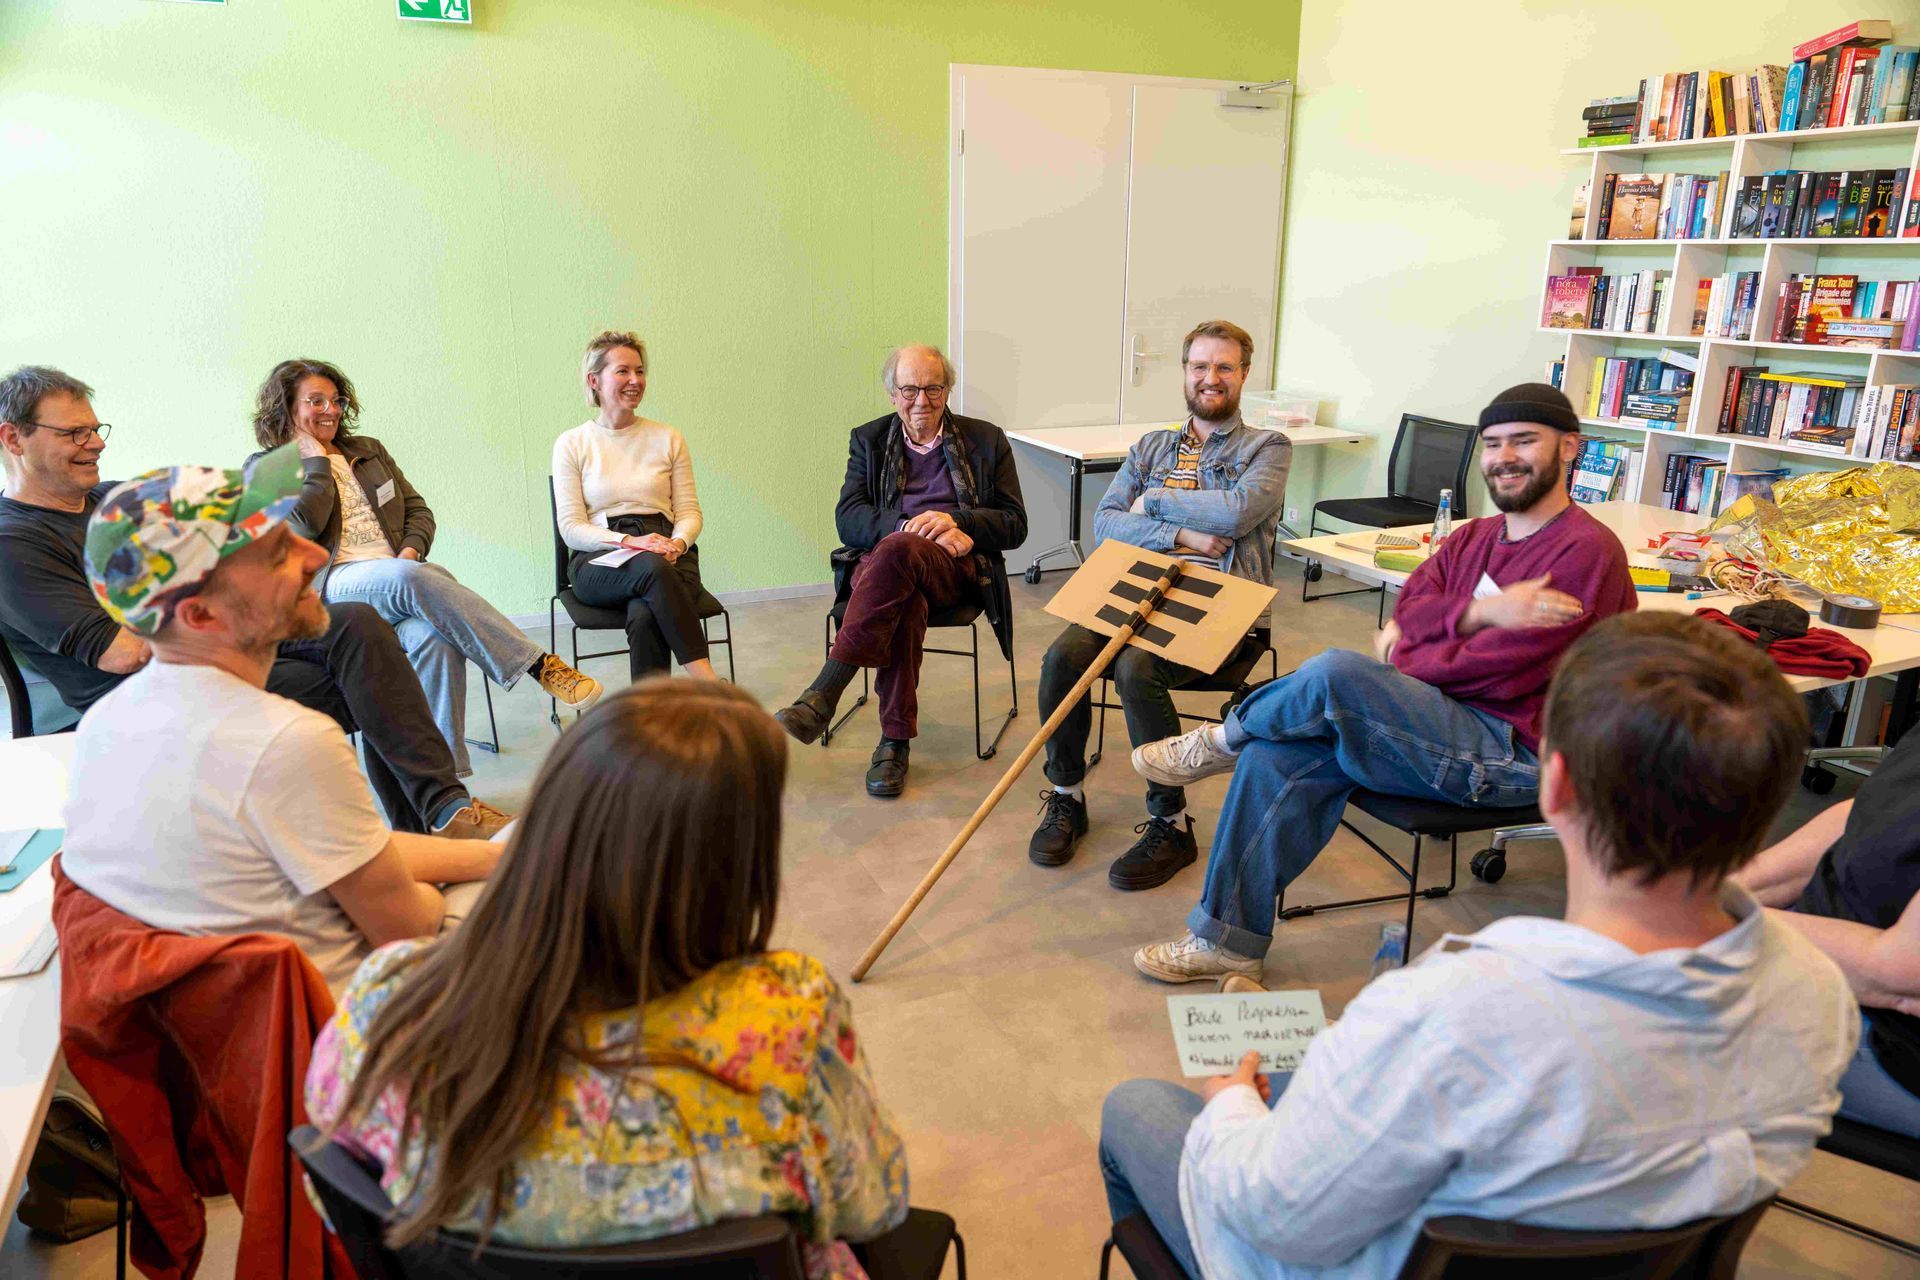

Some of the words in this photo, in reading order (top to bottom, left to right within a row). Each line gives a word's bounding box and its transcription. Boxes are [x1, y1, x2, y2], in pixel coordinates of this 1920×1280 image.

[1617, 185, 1639, 193] Hannas
[1639, 184, 1659, 193] Töchter
[1817, 277, 1837, 287] Franz
[1838, 278, 1853, 288] Taut
[1555, 287, 1589, 295] roberts
[1816, 289, 1839, 297] Brigade
[1841, 289, 1852, 297] der
[1813, 297, 1851, 305] Verdammten
[1890, 392, 1904, 429] BONFIRE
